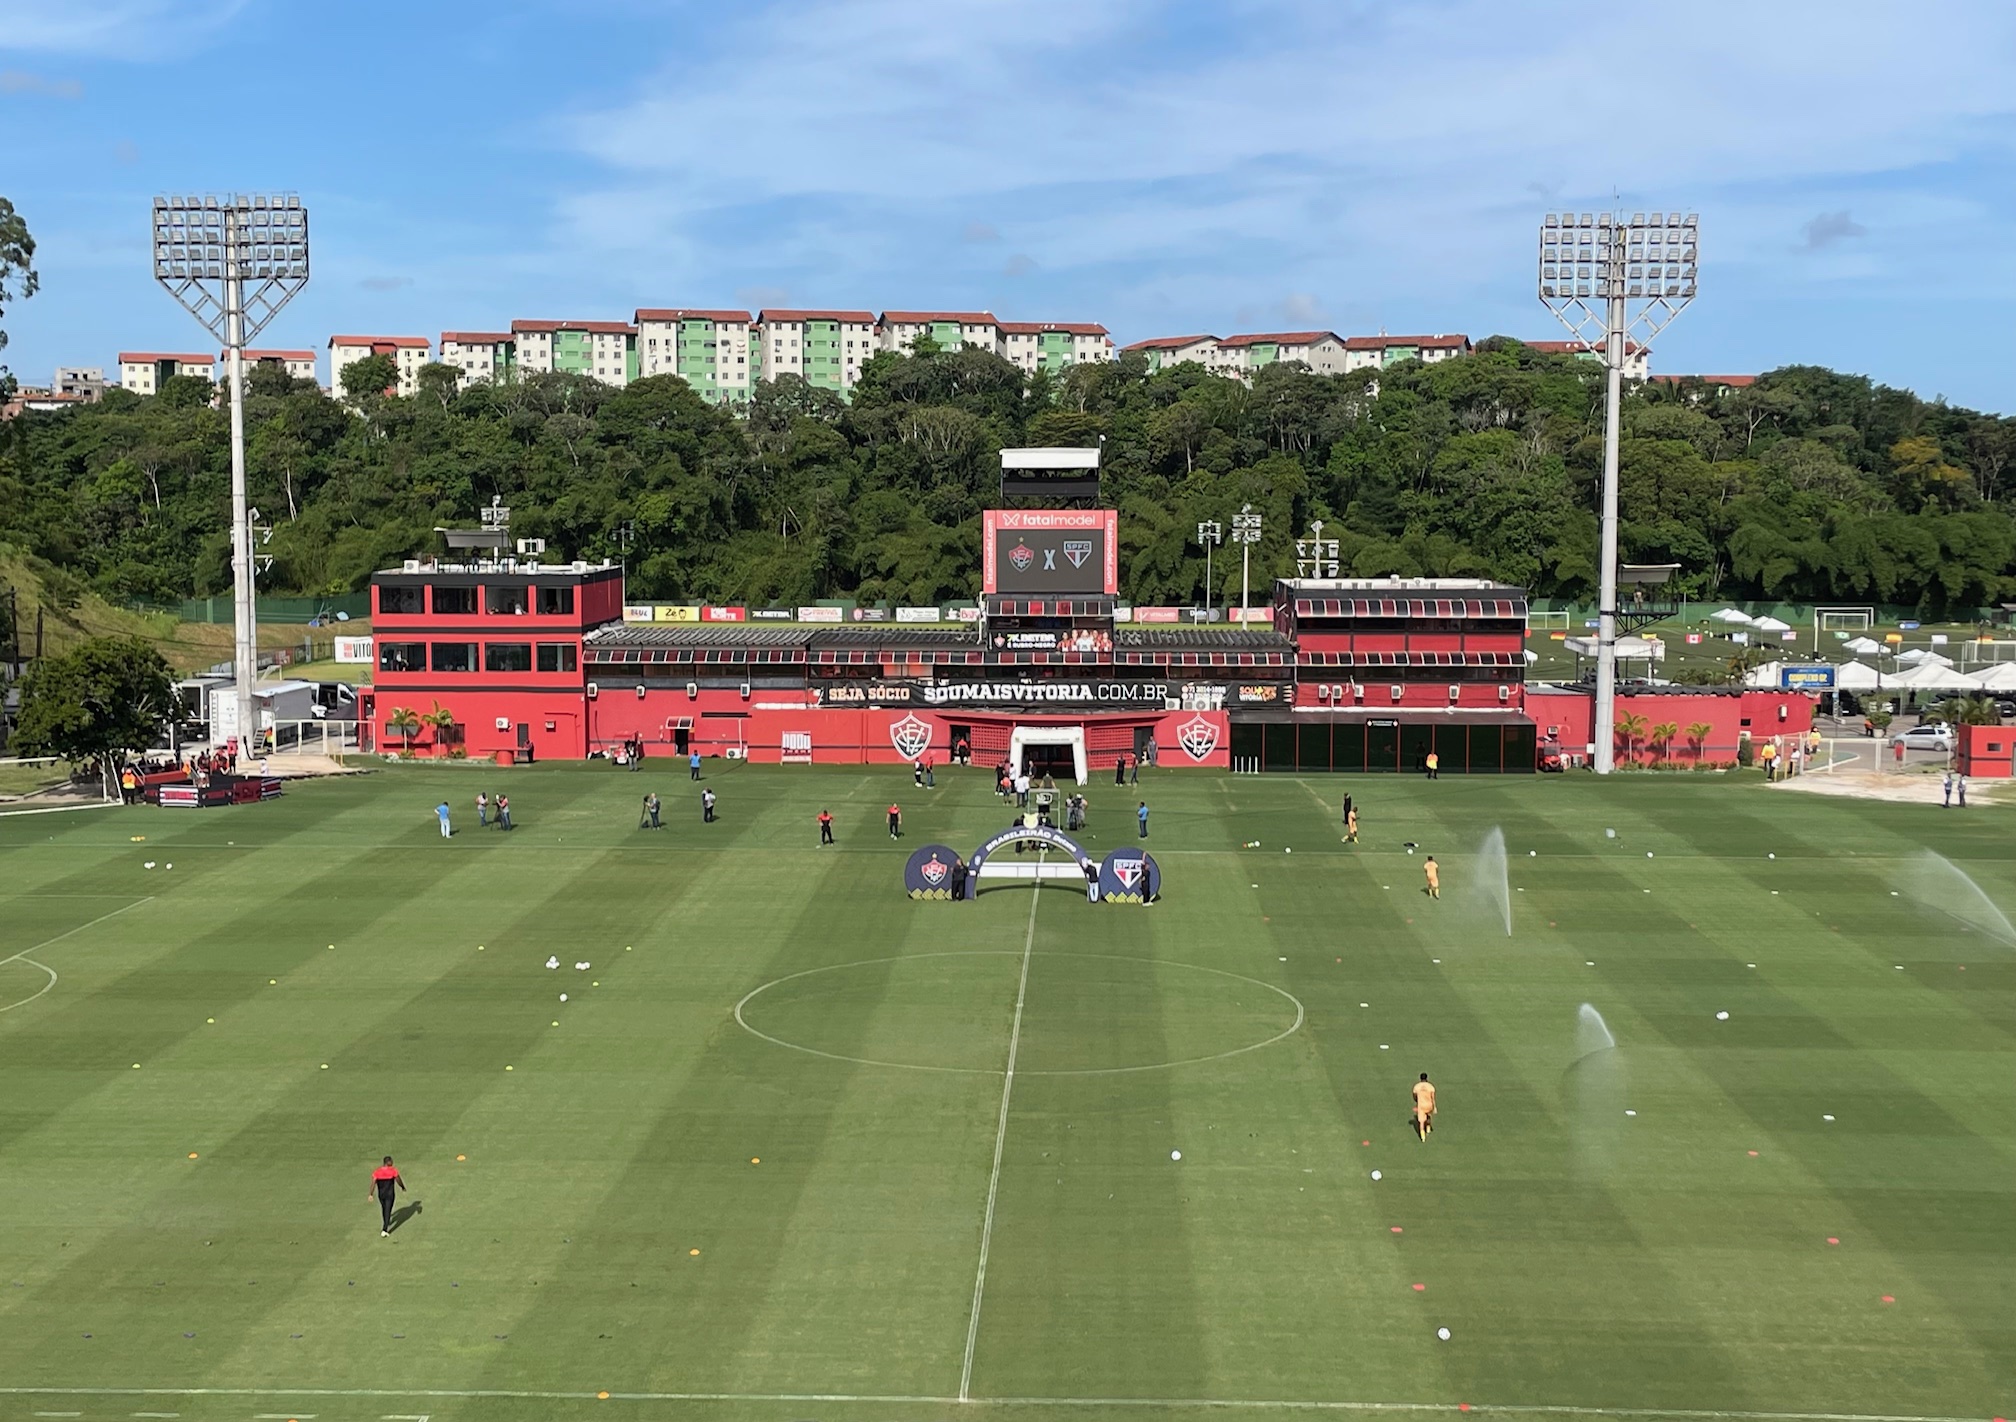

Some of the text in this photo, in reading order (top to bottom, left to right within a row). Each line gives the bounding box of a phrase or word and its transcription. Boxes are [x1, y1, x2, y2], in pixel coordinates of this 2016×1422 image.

[1023, 514, 1096, 526] fatalmodel
[986, 519, 994, 585] fatalmodel.com
[1043, 549, 1056, 570] X
[1106, 519, 1115, 585] fatalmodel.com
[353, 642, 374, 657] VITO
[829, 684, 910, 701] SEJA SÓCIO
[924, 684, 1168, 703] SOUMAISVITORIA.COM.BR
[985, 829, 1052, 852] BRASILEIRÃO
[1116, 861, 1142, 870] SPFC
